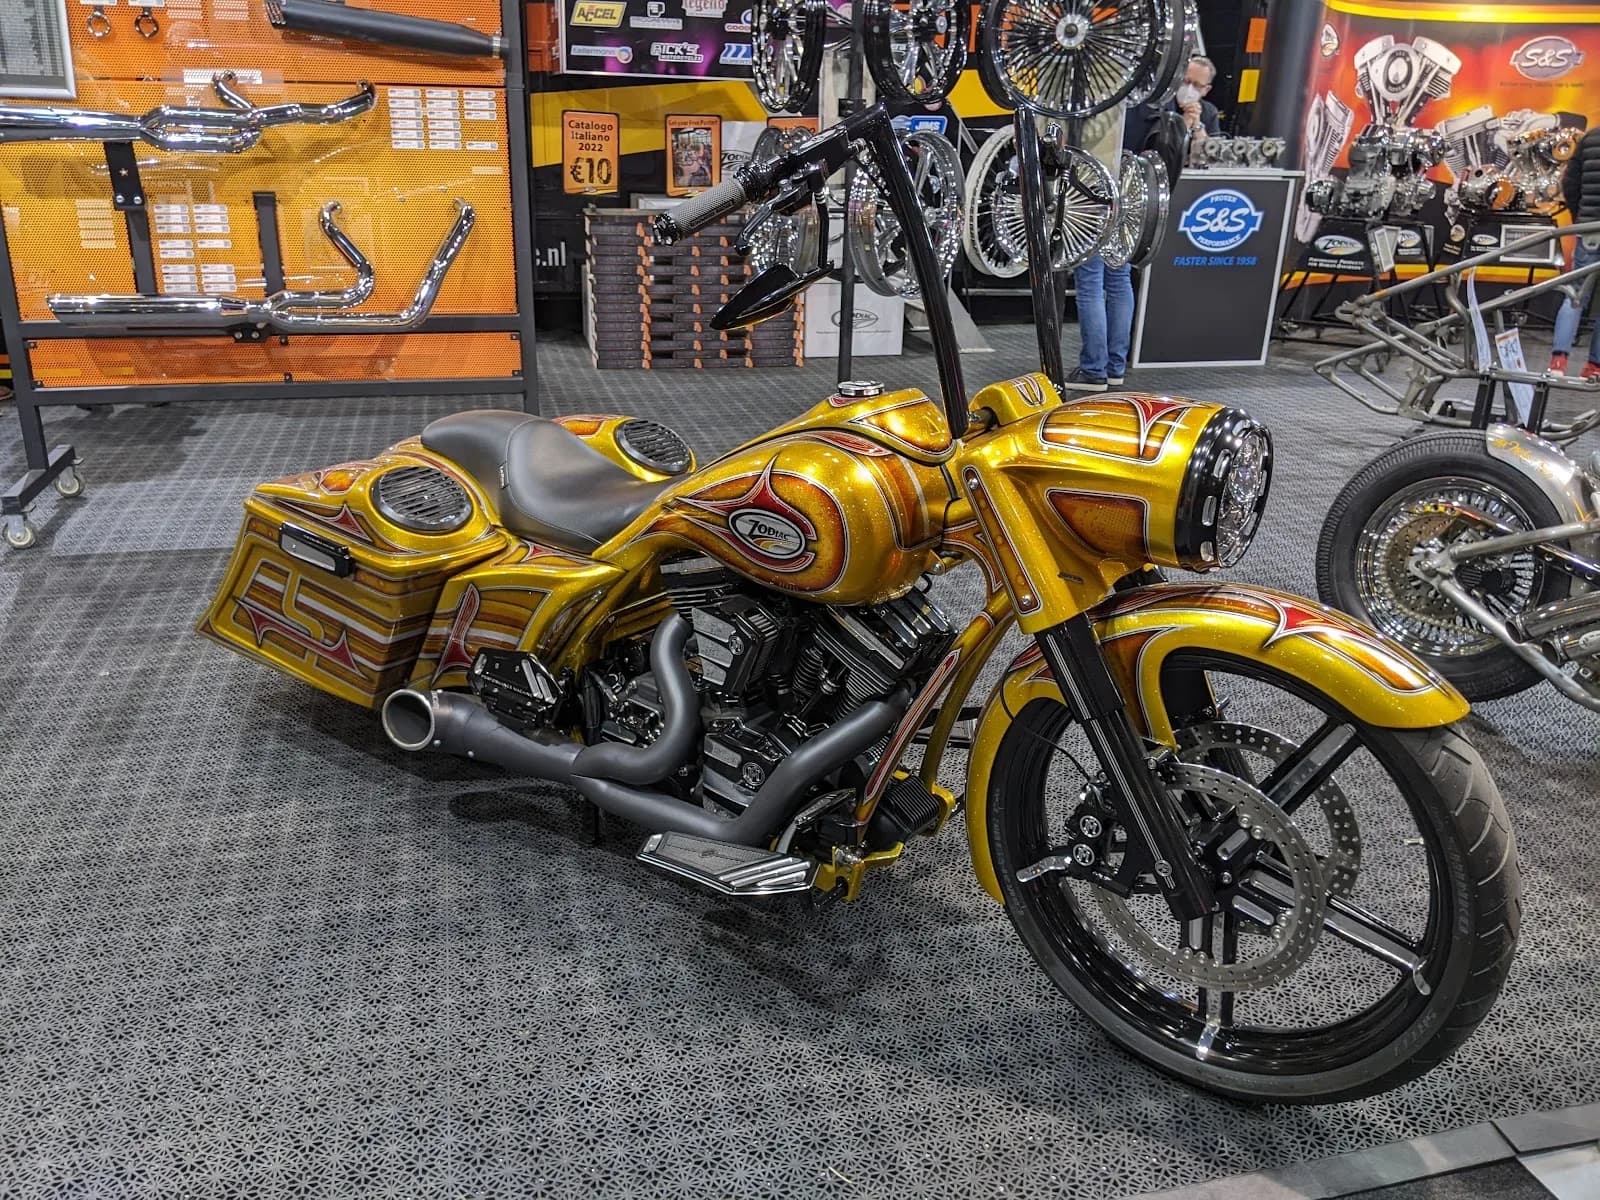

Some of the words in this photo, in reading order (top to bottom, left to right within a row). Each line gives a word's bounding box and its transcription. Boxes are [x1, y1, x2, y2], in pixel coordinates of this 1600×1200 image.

[652, 44, 697, 55] RICK'S
[1521, 49, 1573, 68] S&S
[568, 120, 613, 132] Catalogo
[571, 131, 610, 142] Italiano
[578, 143, 603, 152] 2022
[570, 157, 612, 184] €10
[1191, 208, 1250, 233] S&S
[1173, 256, 1206, 266] FASTER
[1207, 256, 1234, 266] SINCE
[1236, 256, 1257, 266] 1958
[748, 519, 789, 542] ZODIAC
